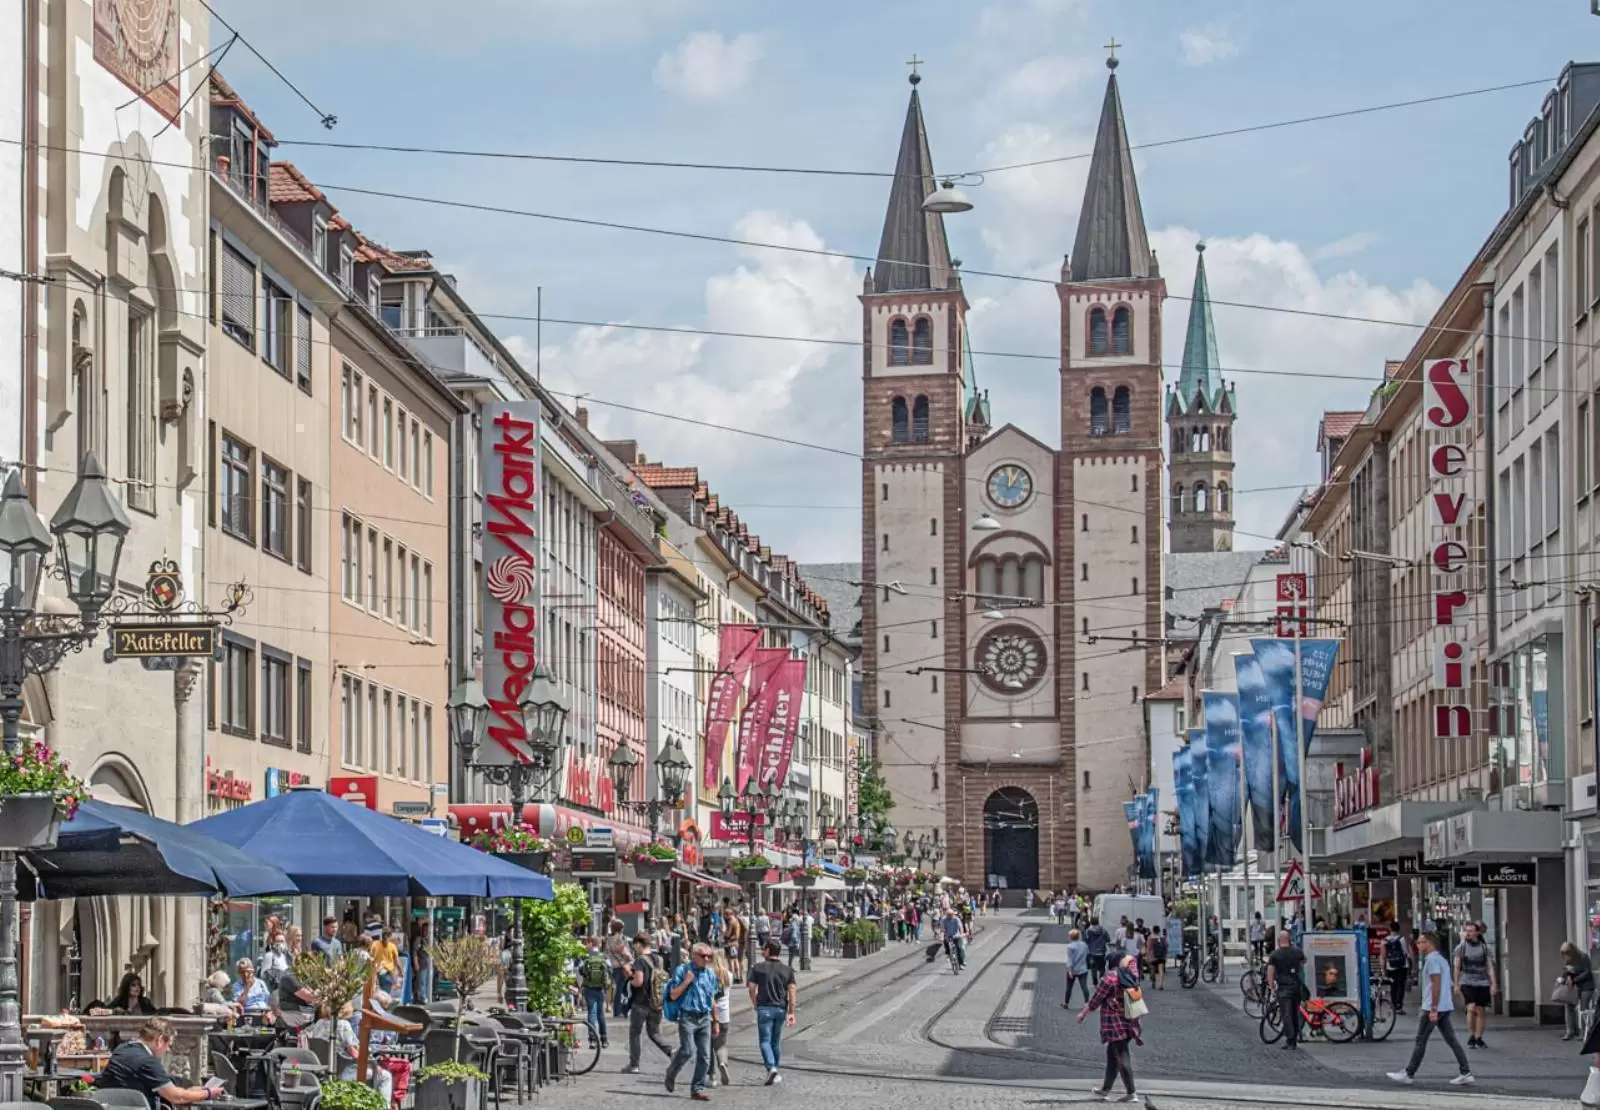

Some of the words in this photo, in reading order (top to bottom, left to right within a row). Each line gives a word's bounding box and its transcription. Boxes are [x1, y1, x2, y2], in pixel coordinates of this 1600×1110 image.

[486, 412, 534, 570] Markt
[1428, 359, 1471, 737] Severin
[121, 632, 205, 651] Ratskeller
[487, 602, 535, 767] Media
[762, 689, 790, 782] Schlier
[848, 748, 858, 814] APOTHE
[571, 829, 580, 840] H
[1487, 873, 1528, 882] LACOSTE
